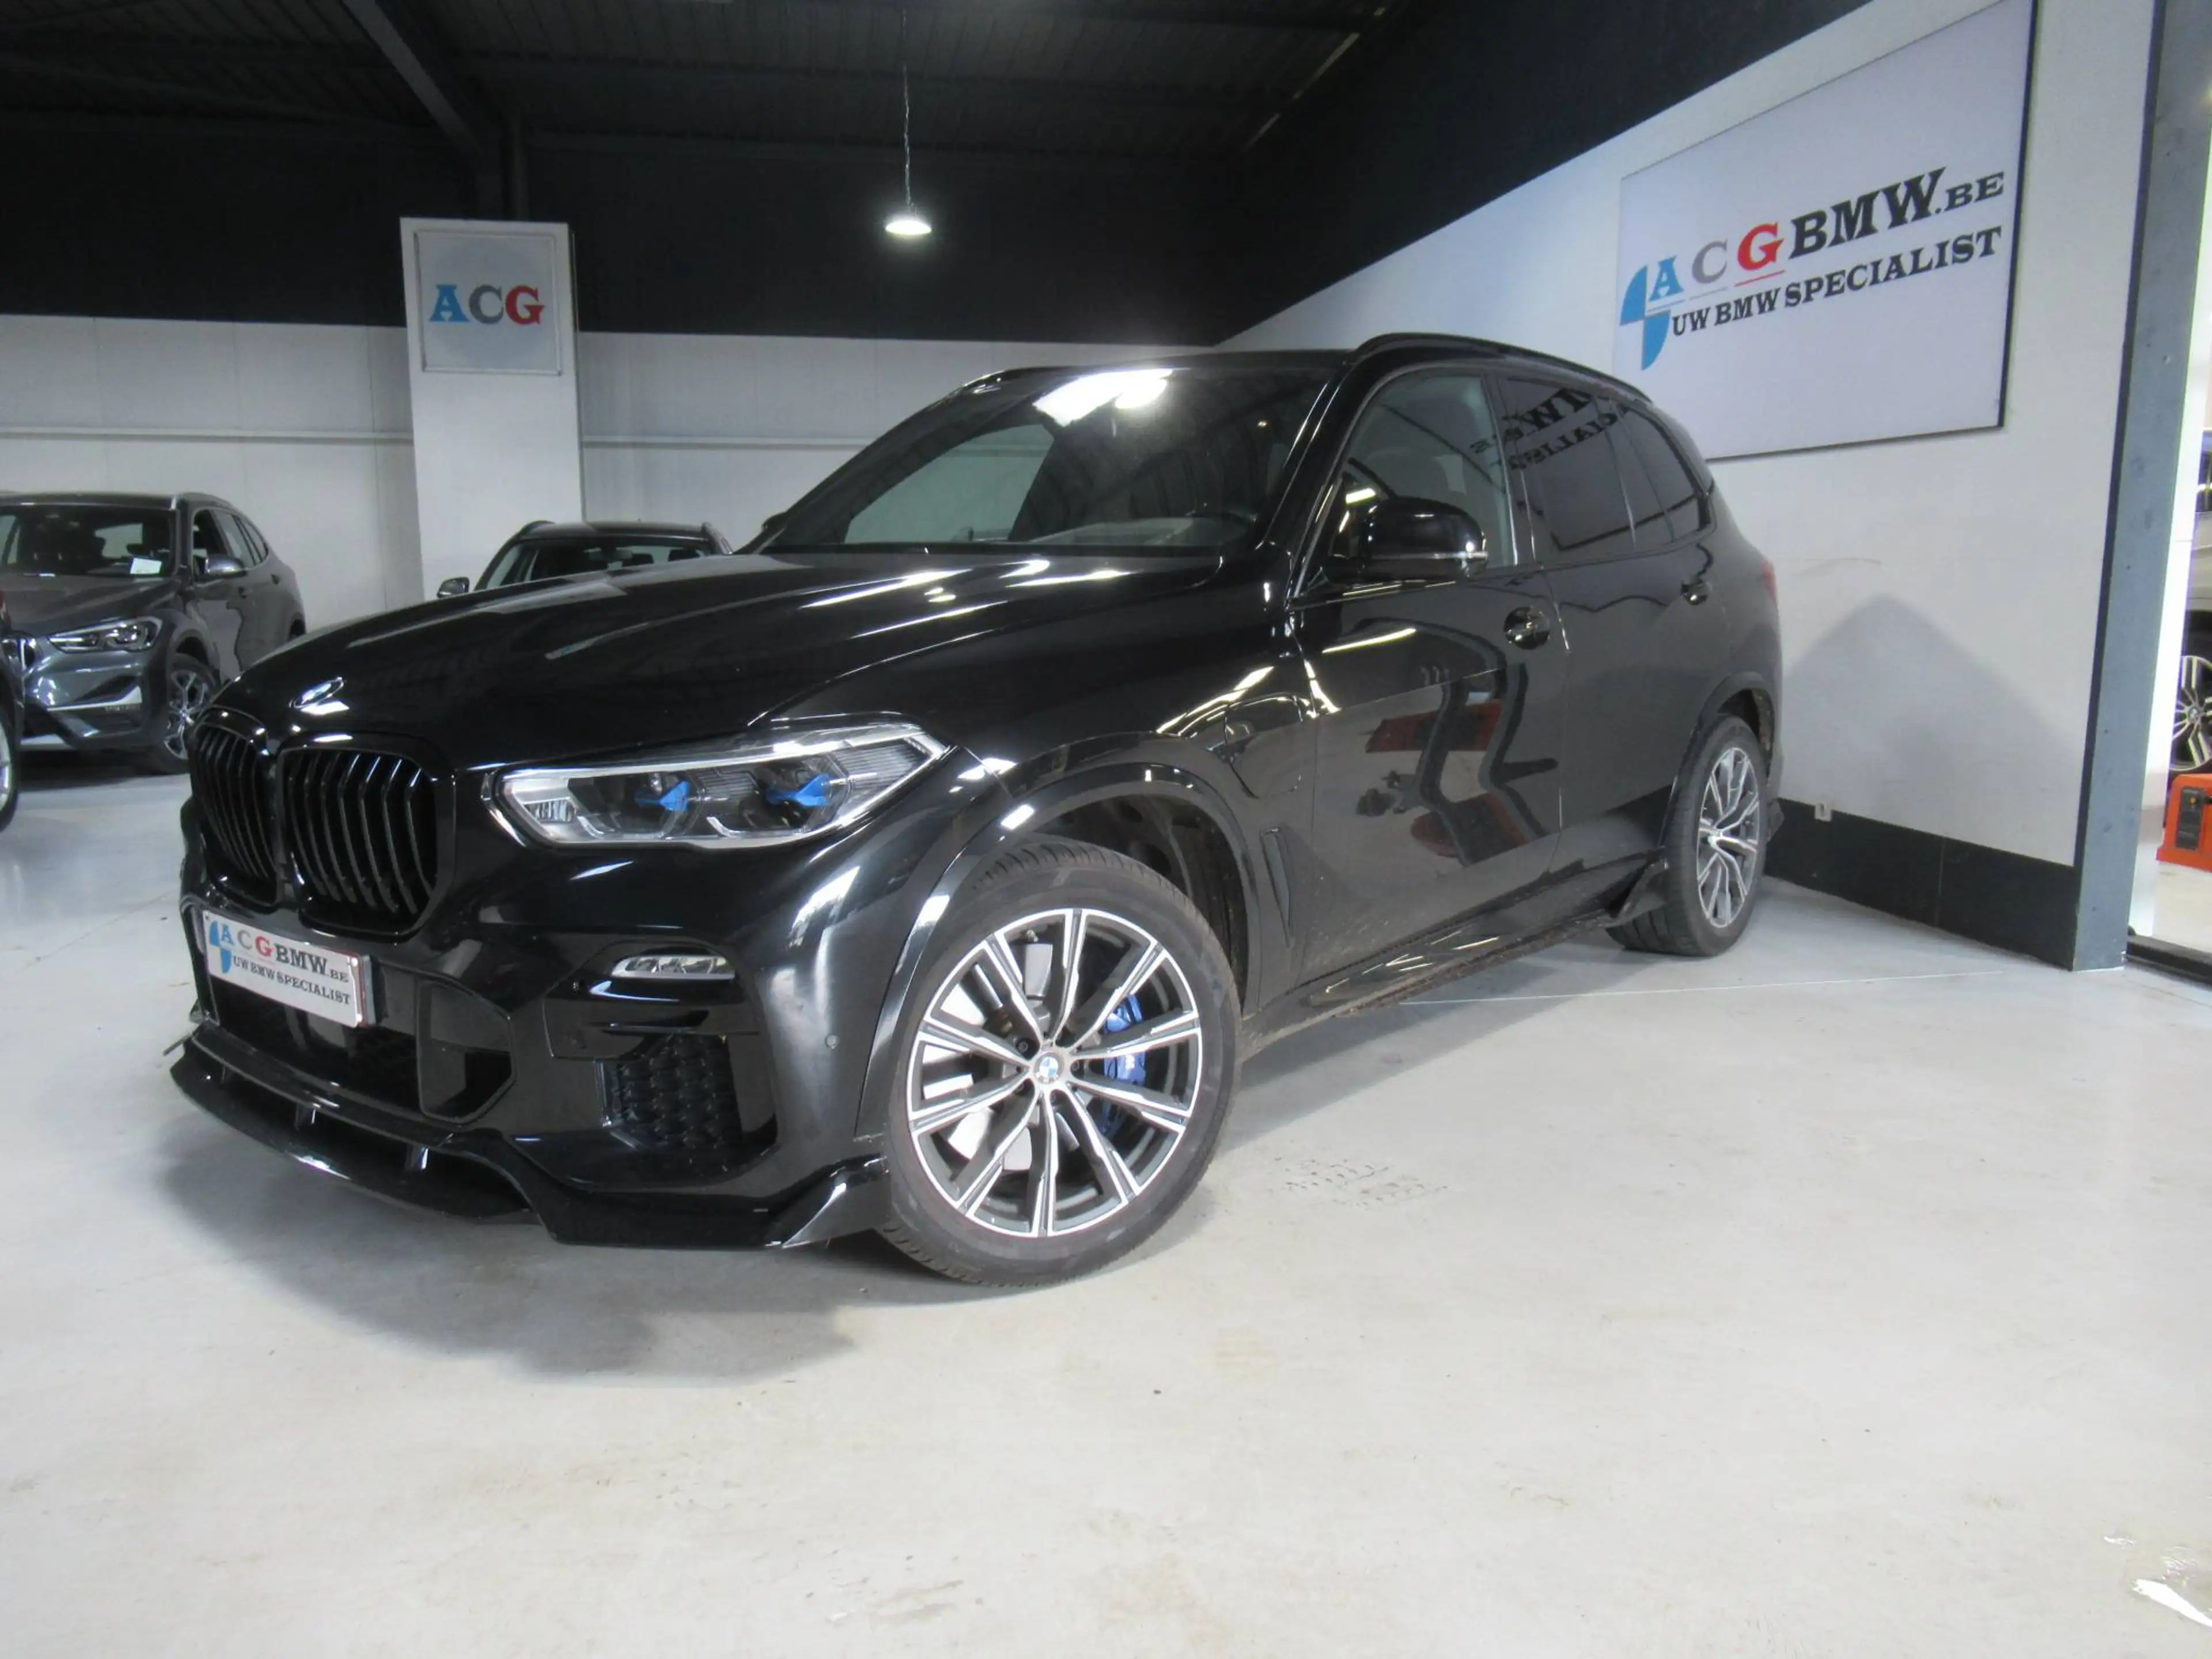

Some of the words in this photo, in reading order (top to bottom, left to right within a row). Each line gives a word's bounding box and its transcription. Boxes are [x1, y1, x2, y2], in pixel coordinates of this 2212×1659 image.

[429, 283, 546, 325] ACG
[1672, 307, 1709, 336] UW
[1714, 287, 1781, 327] BMW
[1784, 226, 2002, 308] SPECIALIST
[233, 955, 249, 970] UW
[250, 961, 275, 980] BMW
[276, 971, 351, 1005] SPECIALIST
